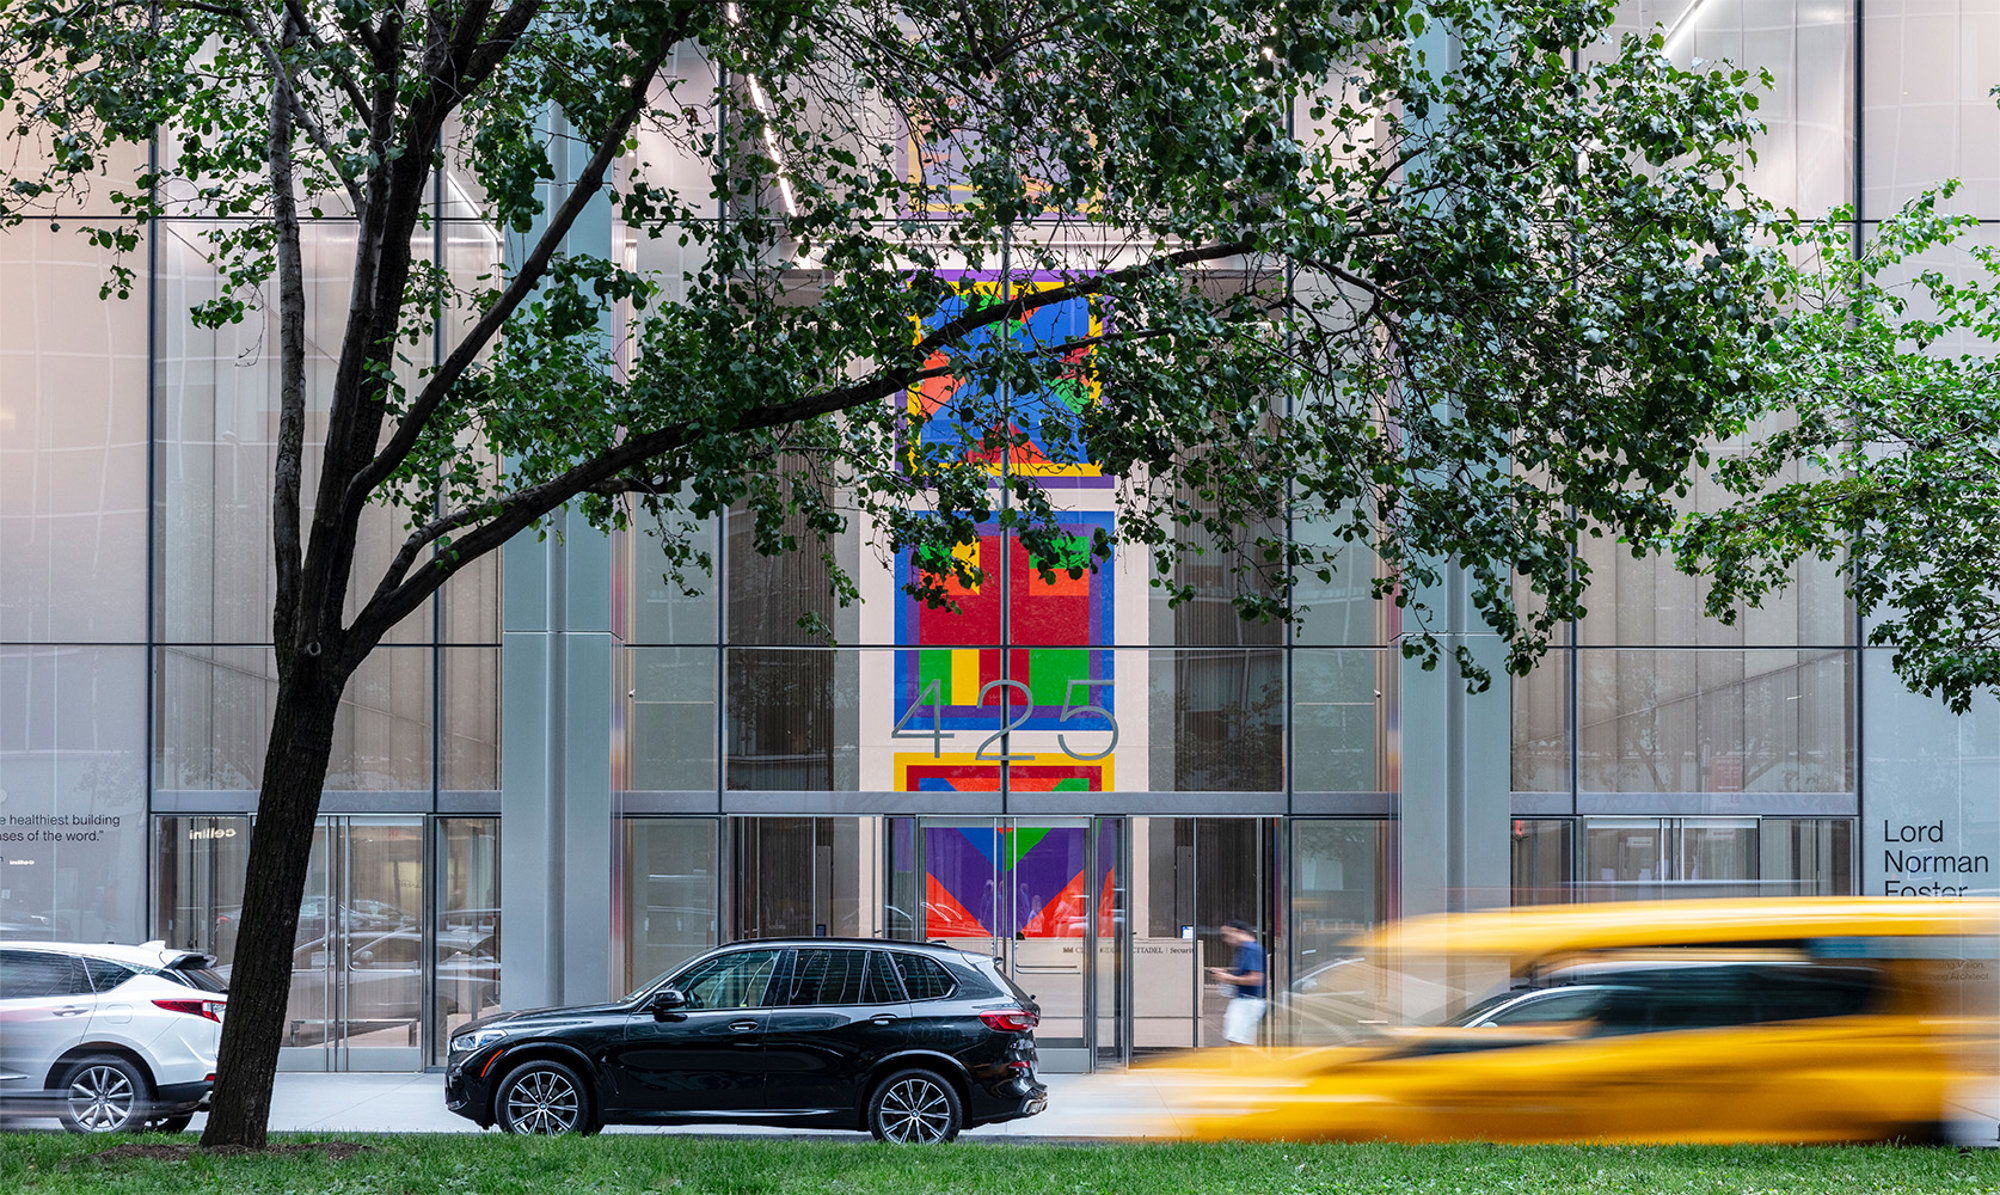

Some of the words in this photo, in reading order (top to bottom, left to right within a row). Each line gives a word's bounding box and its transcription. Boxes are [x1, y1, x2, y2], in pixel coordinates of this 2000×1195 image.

[891, 679, 1119, 761] 425
[9, 814, 69, 826] healthiest
[72, 814, 120, 827] building
[1884, 819, 1943, 842] Lord
[27, 830, 39, 841] of
[43, 830, 62, 841] the
[1884, 850, 1989, 873] Norman
[1884, 880, 1968, 897] Foster
